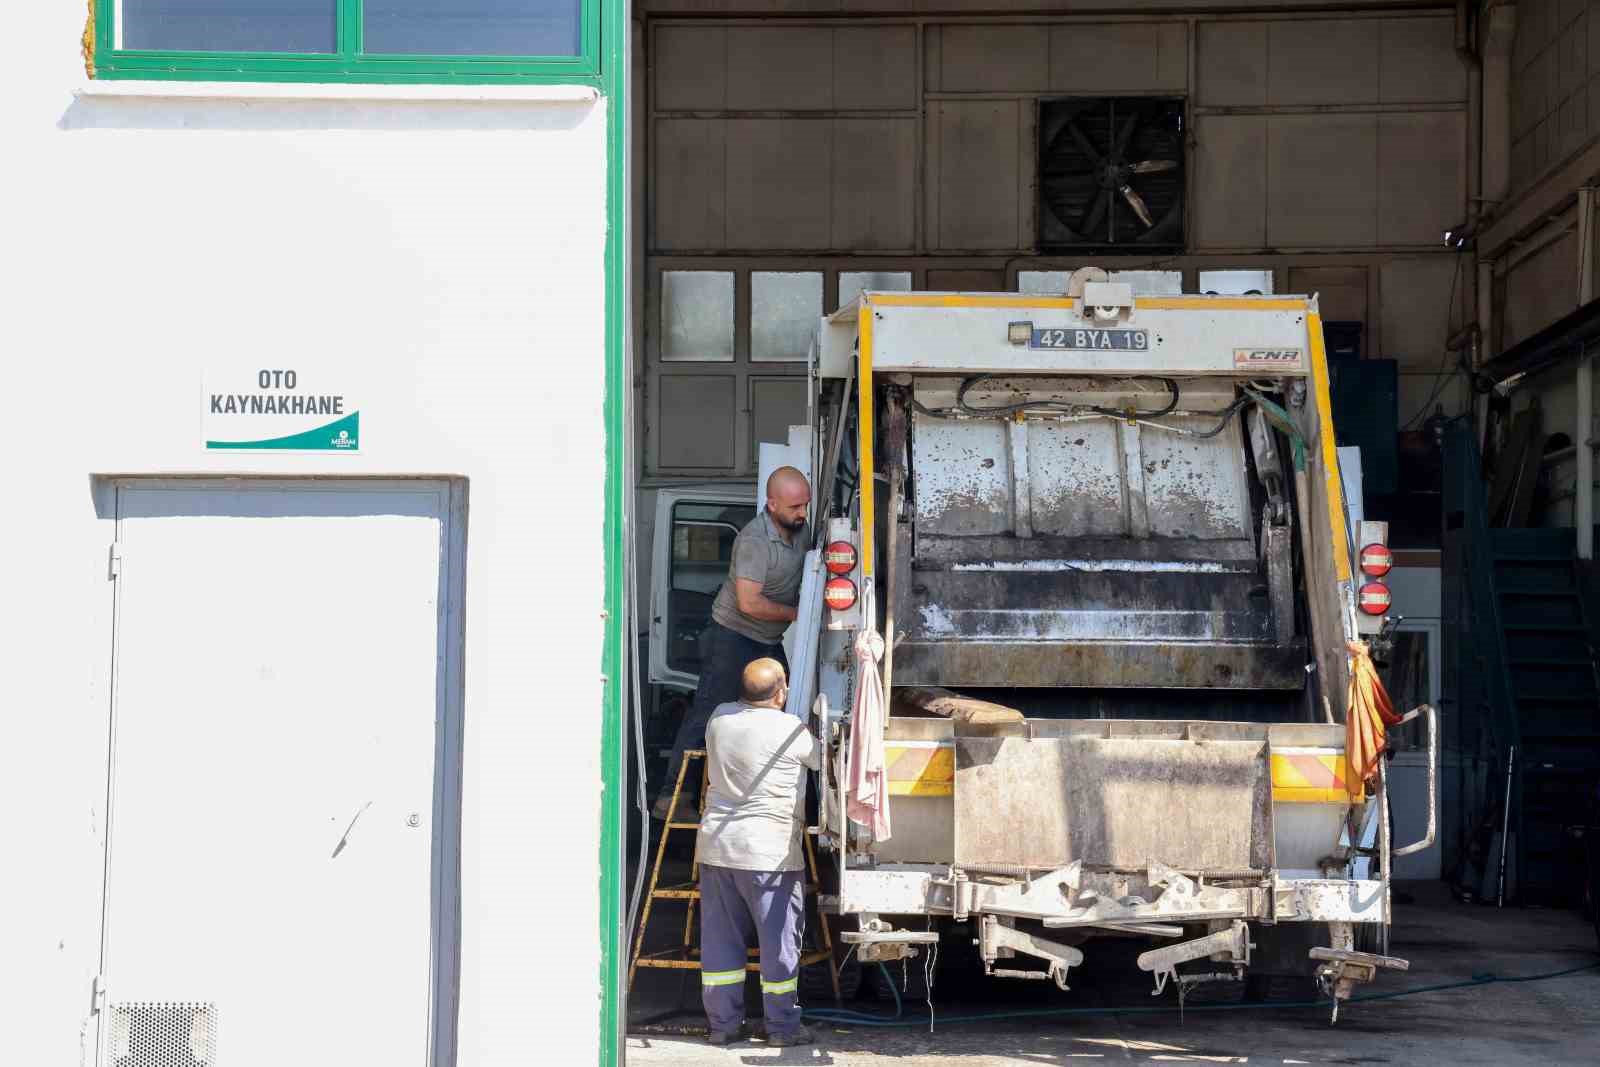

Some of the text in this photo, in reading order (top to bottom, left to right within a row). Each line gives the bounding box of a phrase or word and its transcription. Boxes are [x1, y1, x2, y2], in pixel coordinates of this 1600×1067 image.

[1040, 330, 1146, 349] 42 BYA 19
[258, 369, 297, 389] OTO
[210, 394, 344, 415] KAYNAKHANE
